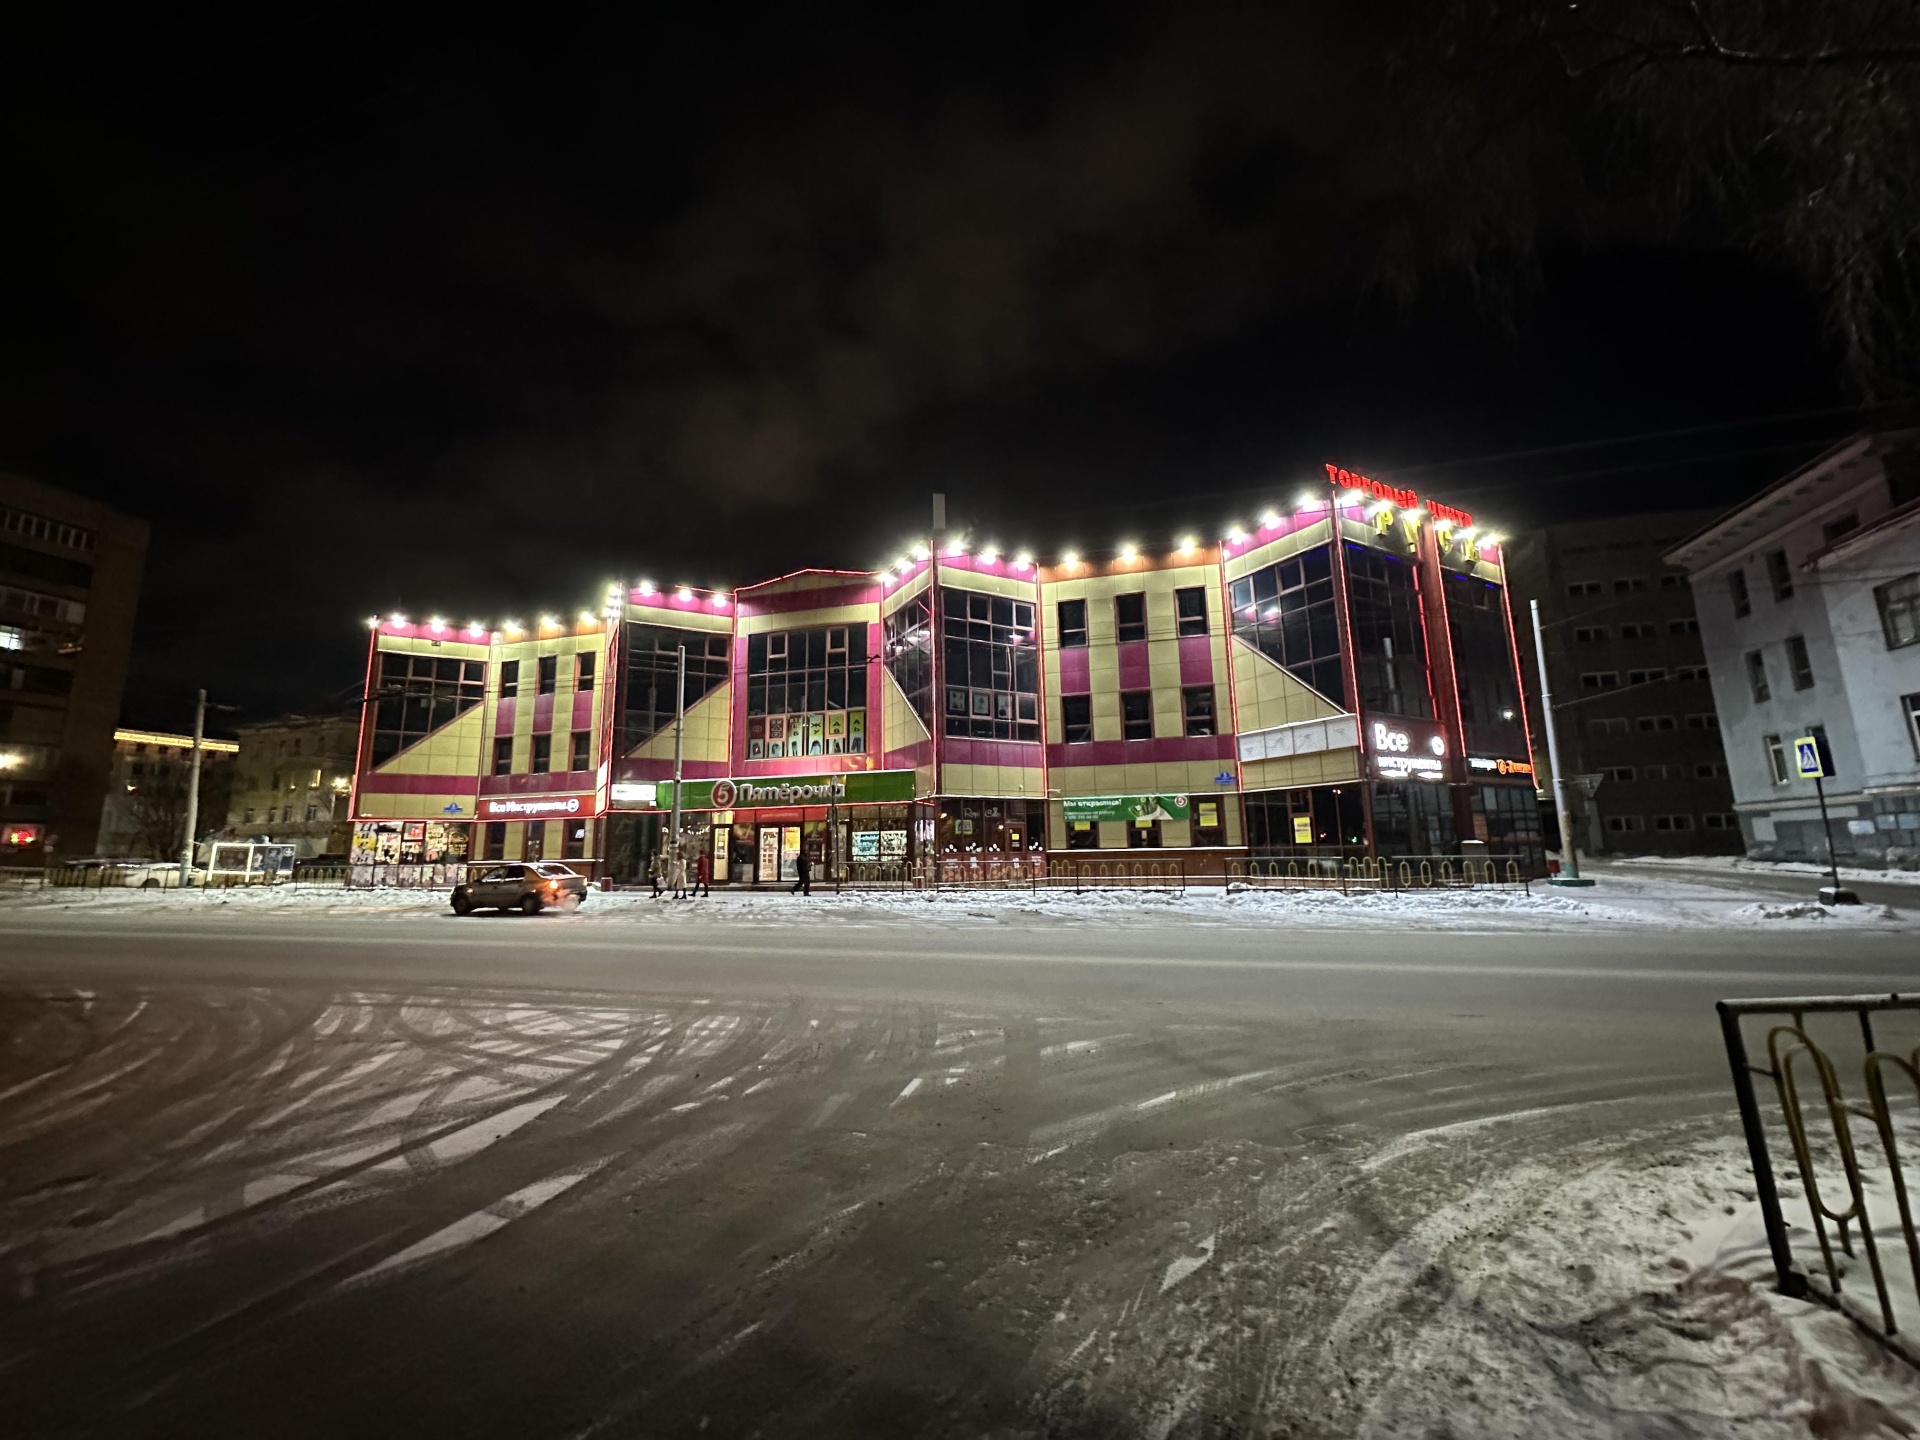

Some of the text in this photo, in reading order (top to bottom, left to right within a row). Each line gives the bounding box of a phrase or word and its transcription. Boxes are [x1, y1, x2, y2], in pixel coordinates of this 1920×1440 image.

[1325, 463, 1473, 528] ТОРГОВЫЙ ЦЕНТР
[1374, 723, 1409, 752] Все
[740, 783, 846, 804] Пятёрочка
[1077, 798, 1122, 808] открылись!
